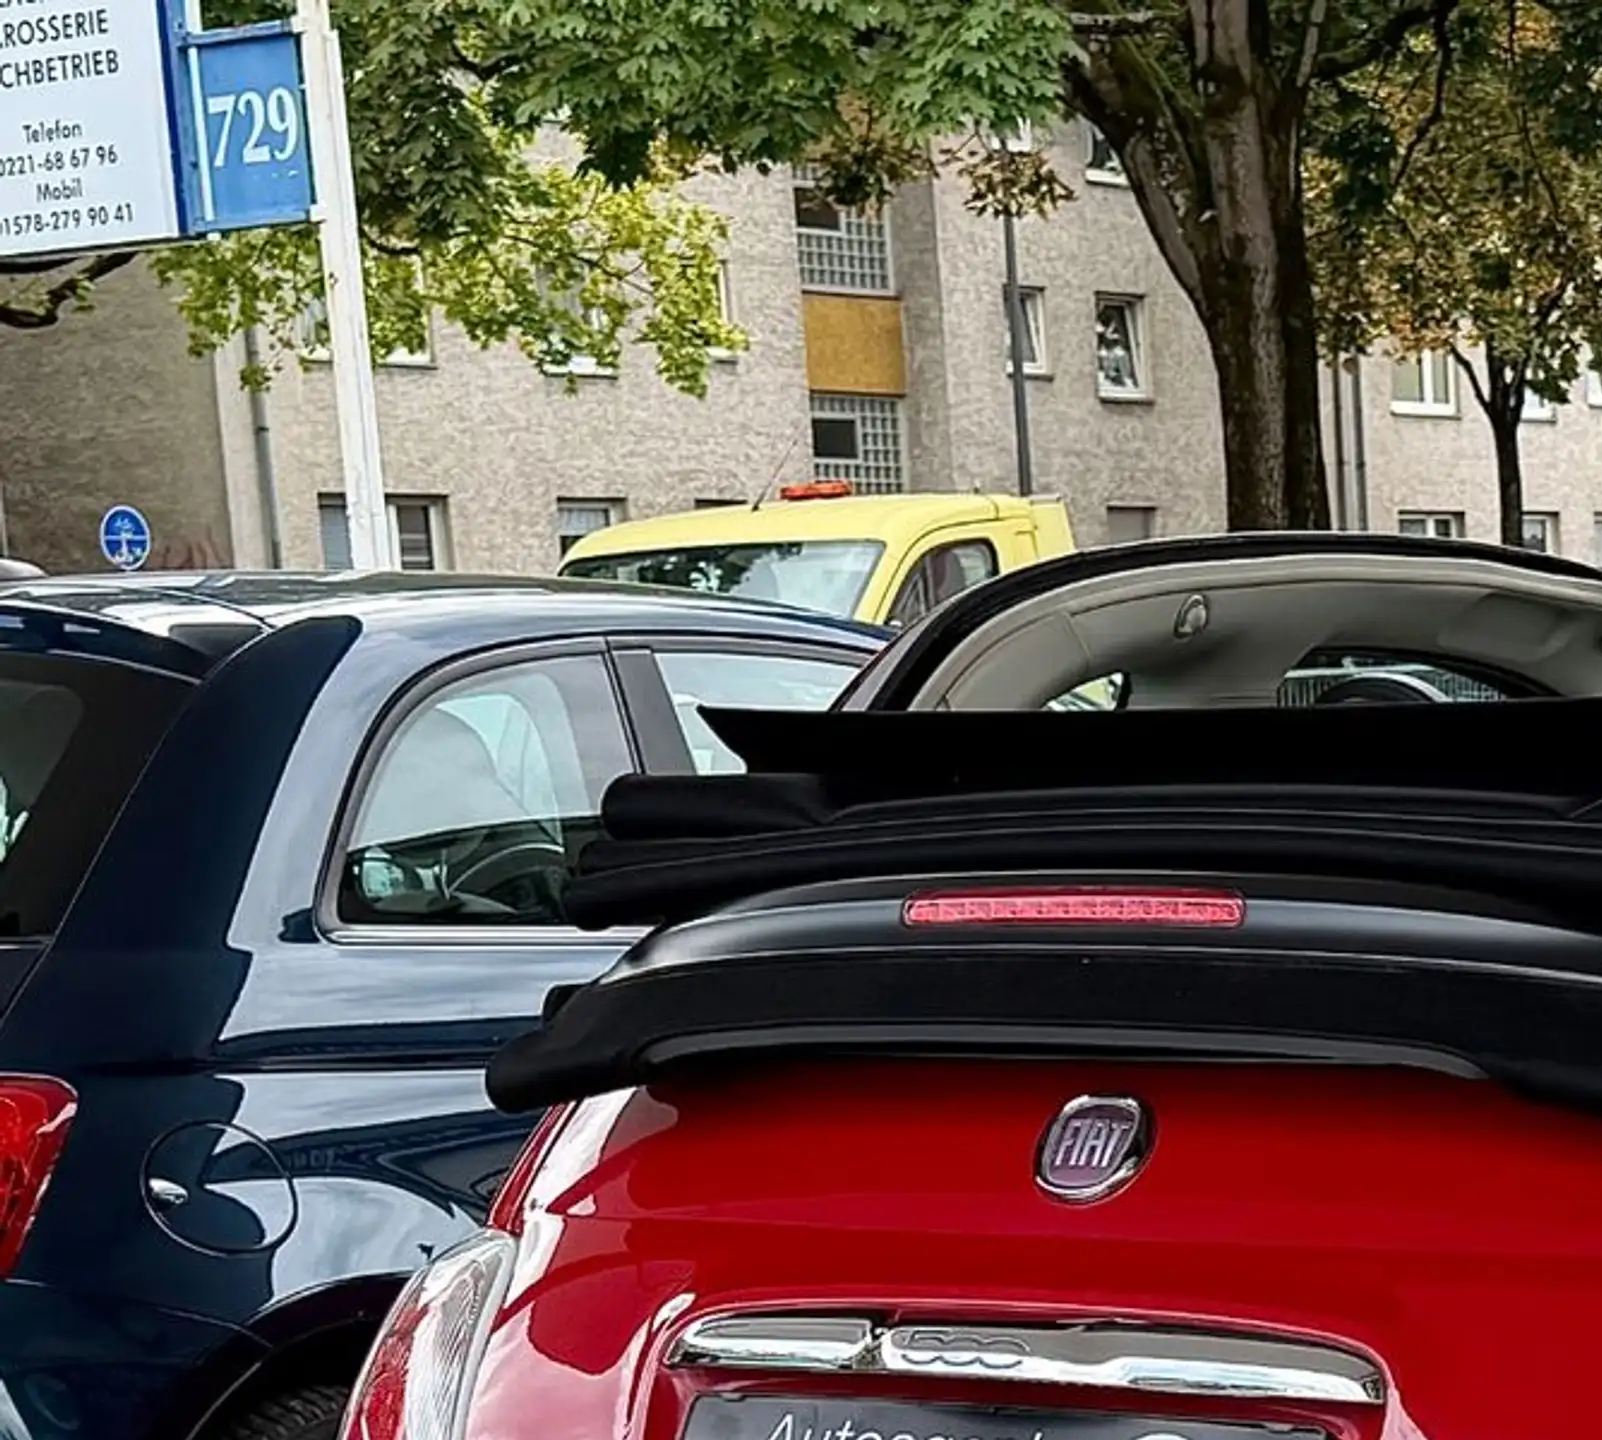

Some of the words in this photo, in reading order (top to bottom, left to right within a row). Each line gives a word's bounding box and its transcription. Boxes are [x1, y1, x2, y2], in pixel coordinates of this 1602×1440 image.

[0, 9, 109, 48] ROSSERIE
[22, 119, 82, 142] Telefon
[206, 86, 298, 168] 729
[70, 147, 90, 168] 67
[96, 144, 118, 165] 96
[36, 177, 82, 202] Mobil
[0, 208, 80, 235] 1578-279
[87, 205, 109, 226] 90
[114, 202, 133, 222] 41
[1055, 1118, 1132, 1168] FIAT
